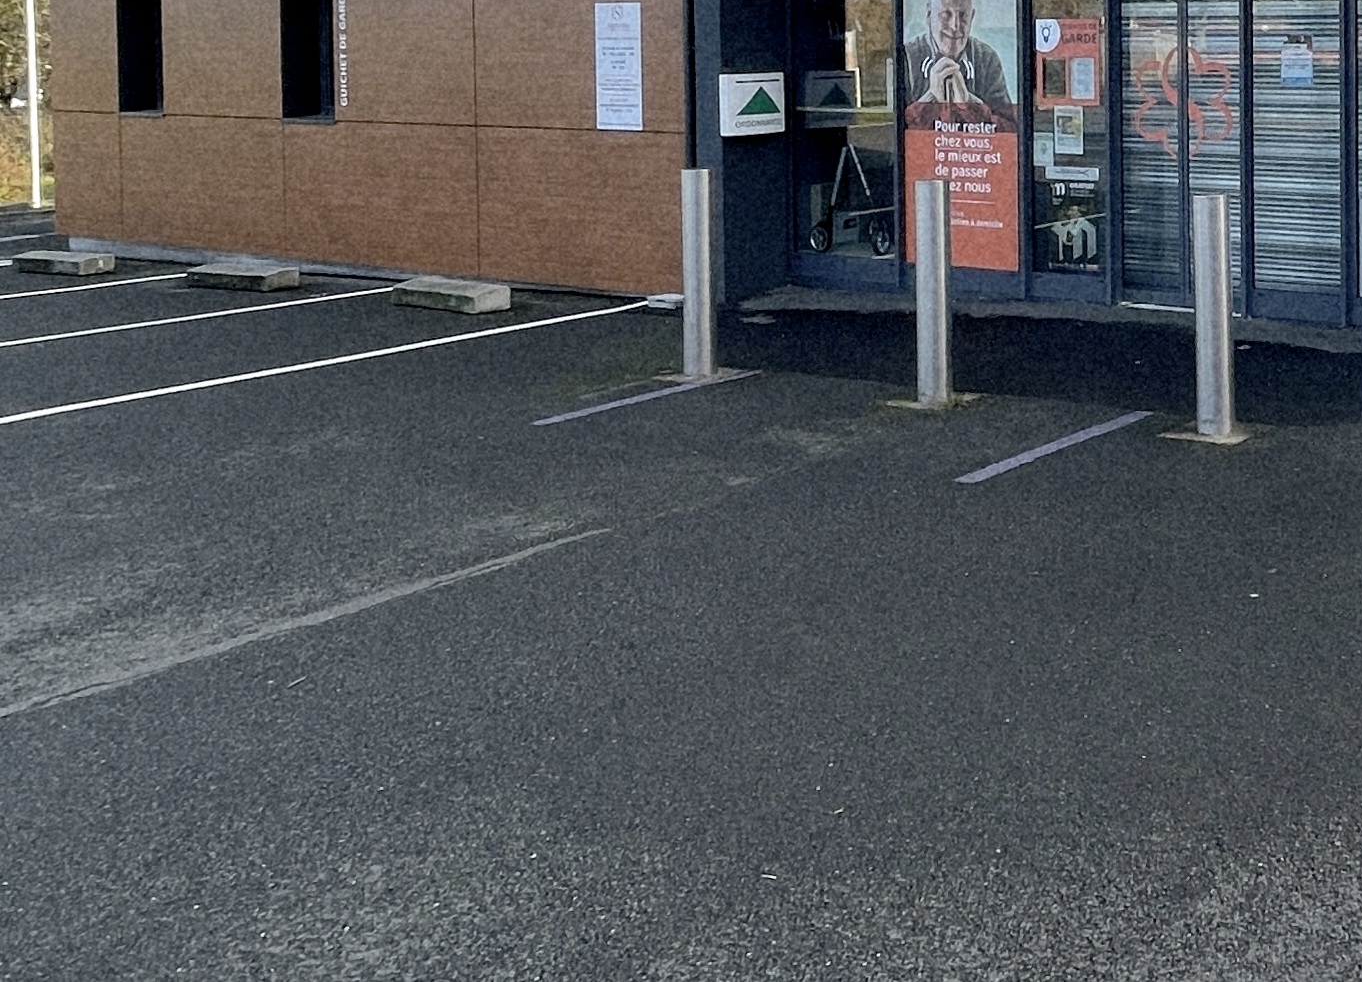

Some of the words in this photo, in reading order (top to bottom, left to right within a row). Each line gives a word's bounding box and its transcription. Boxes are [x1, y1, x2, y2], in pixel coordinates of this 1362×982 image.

[338, 33, 347, 49] DE
[338, 52, 348, 107] GUICHET
[934, 119, 961, 132] Pour
[963, 121, 997, 134] rester
[934, 135, 961, 148] chez
[964, 138, 994, 150] vous,
[935, 148, 946, 162] le
[948, 150, 982, 163] mieux
[984, 152, 1002, 164] est
[935, 163, 949, 176] de
[951, 167, 988, 179] passer
[964, 182, 991, 194] nous
